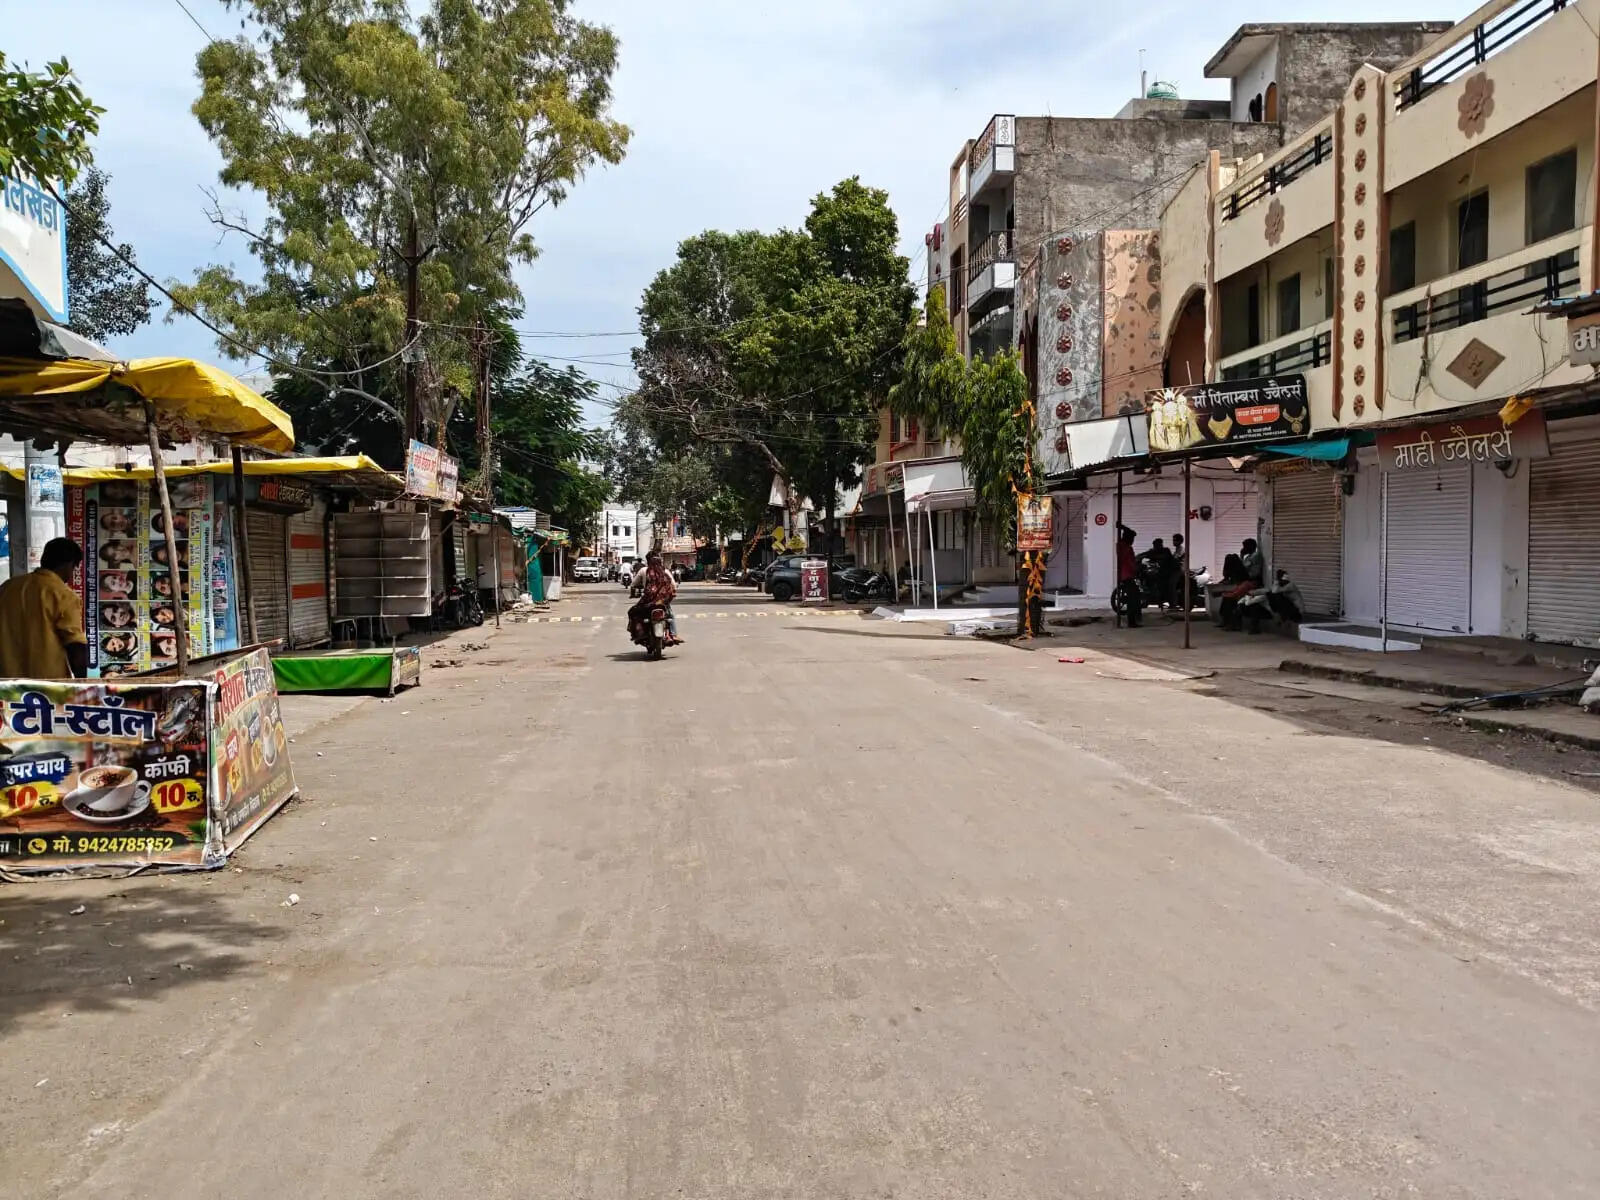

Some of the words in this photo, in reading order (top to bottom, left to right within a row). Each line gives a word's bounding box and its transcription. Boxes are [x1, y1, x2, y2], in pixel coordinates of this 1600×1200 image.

[1393, 431, 1435, 468] माही
[1440, 424, 1512, 462] ज्वैलर्स
[10, 690, 157, 741] टी-स्टॉल
[36, 758, 66, 776] चाय
[145, 754, 191, 779] कॉफी
[7, 786, 38, 811] 10
[157, 783, 187, 808] 10
[53, 837, 75, 854] मो.
